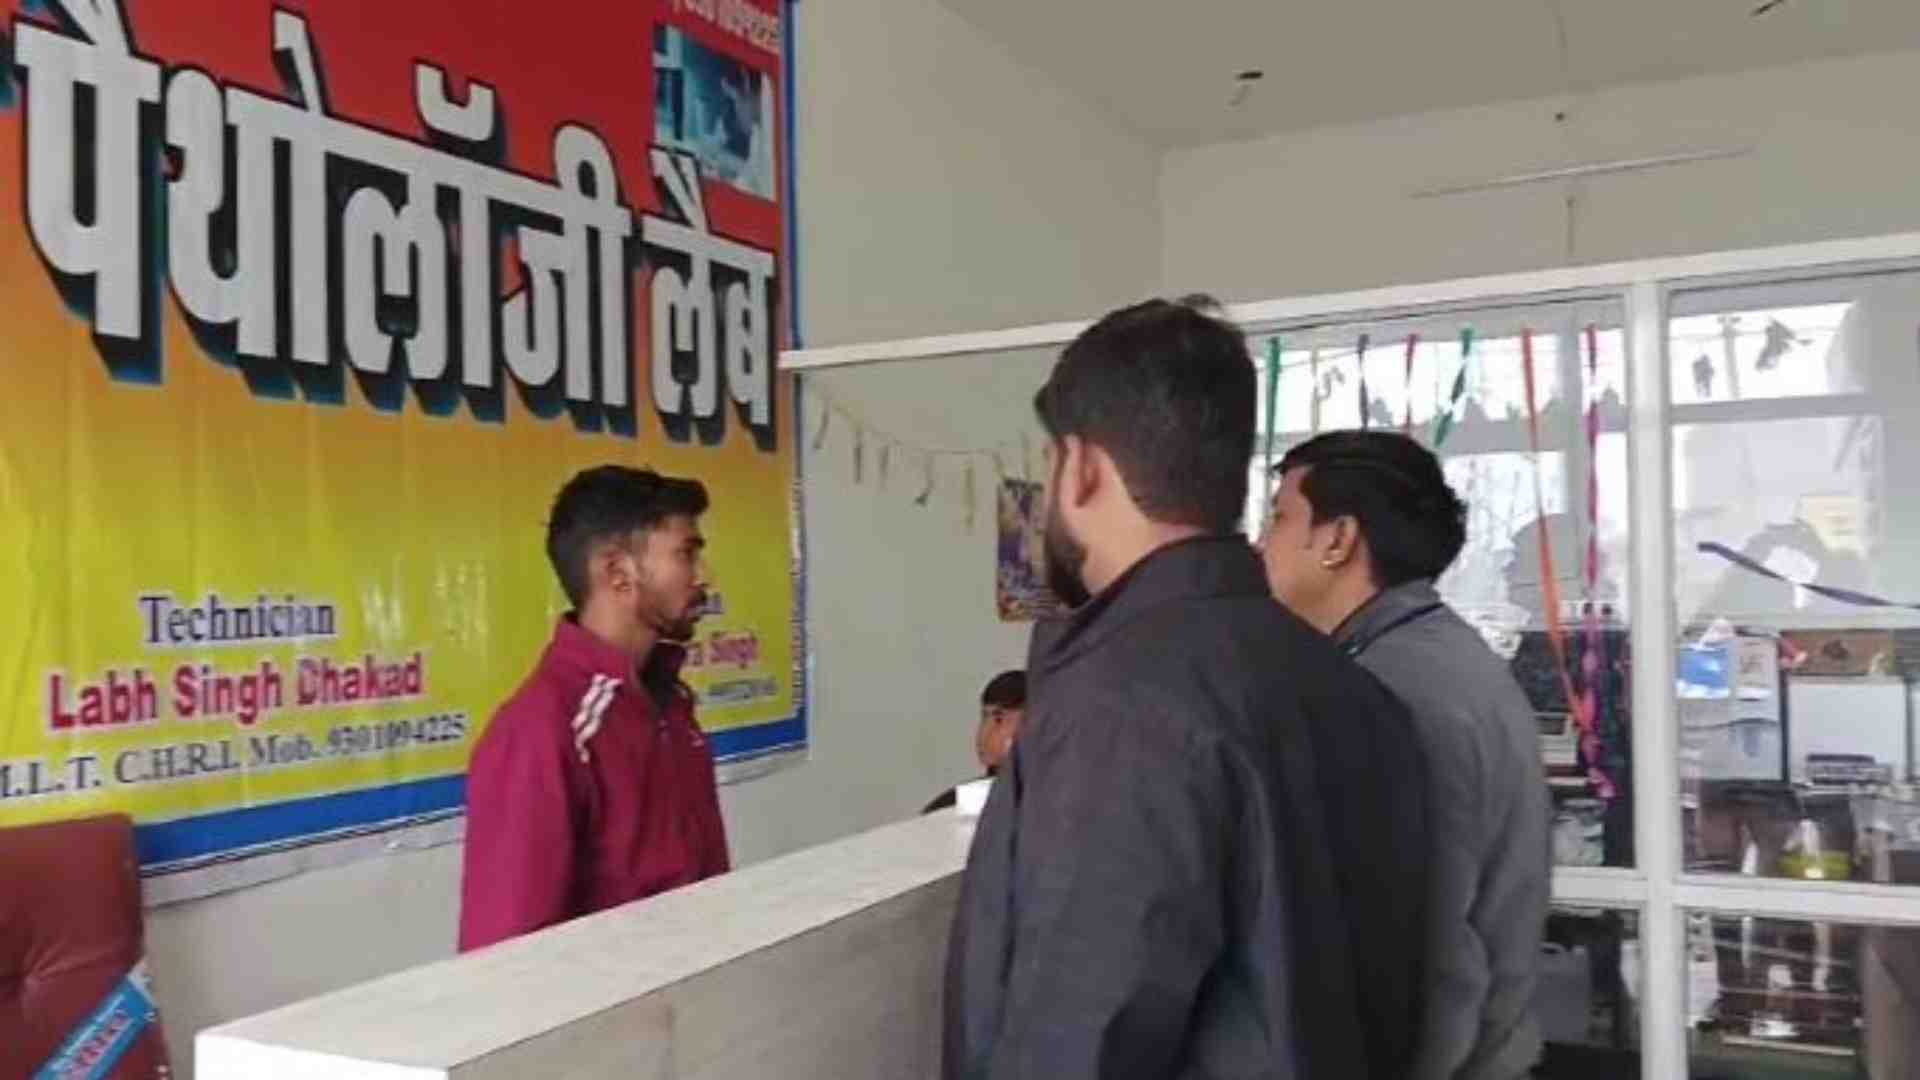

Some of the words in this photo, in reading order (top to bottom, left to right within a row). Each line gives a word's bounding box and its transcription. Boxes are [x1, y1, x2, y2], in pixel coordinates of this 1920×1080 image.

[14, 0, 631, 406] पैथोलॉजी
[642, 152, 775, 425] लैब
[140, 595, 336, 643] Technician
[49, 671, 158, 729] Labh
[172, 661, 283, 725] Singh
[297, 652, 423, 705] Dhakad
